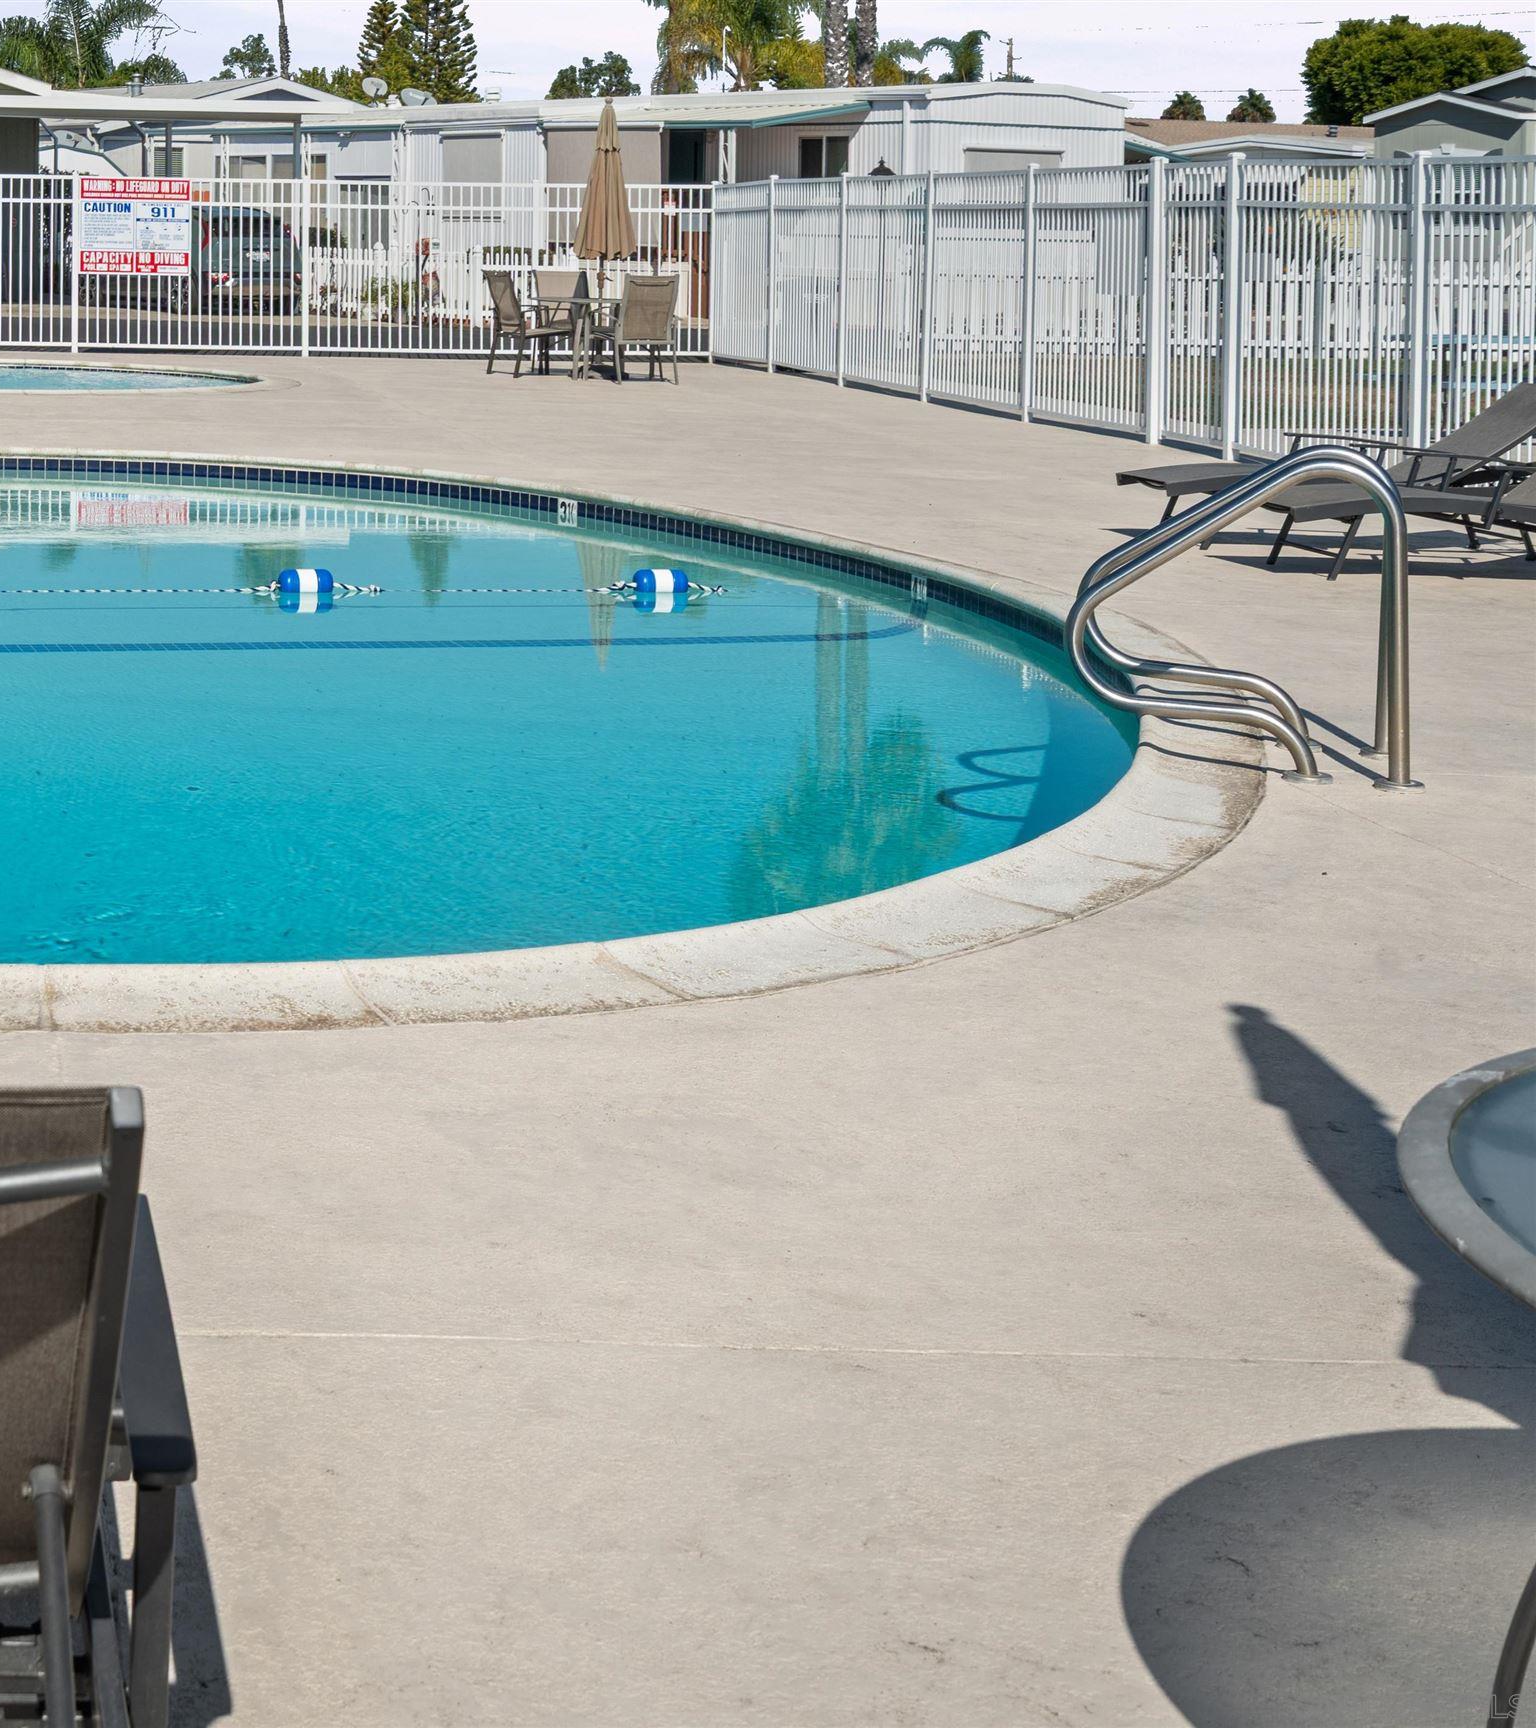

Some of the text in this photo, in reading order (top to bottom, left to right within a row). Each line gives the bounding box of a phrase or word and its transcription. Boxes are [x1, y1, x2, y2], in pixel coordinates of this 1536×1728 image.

[126, 180, 160, 193] LIFEGUARD
[171, 181, 188, 194] DUTY
[84, 202, 132, 213] CAUTION
[151, 206, 176, 218] 911
[82, 251, 133, 264] CAPACITY
[139, 252, 185, 265] NO DIVING
